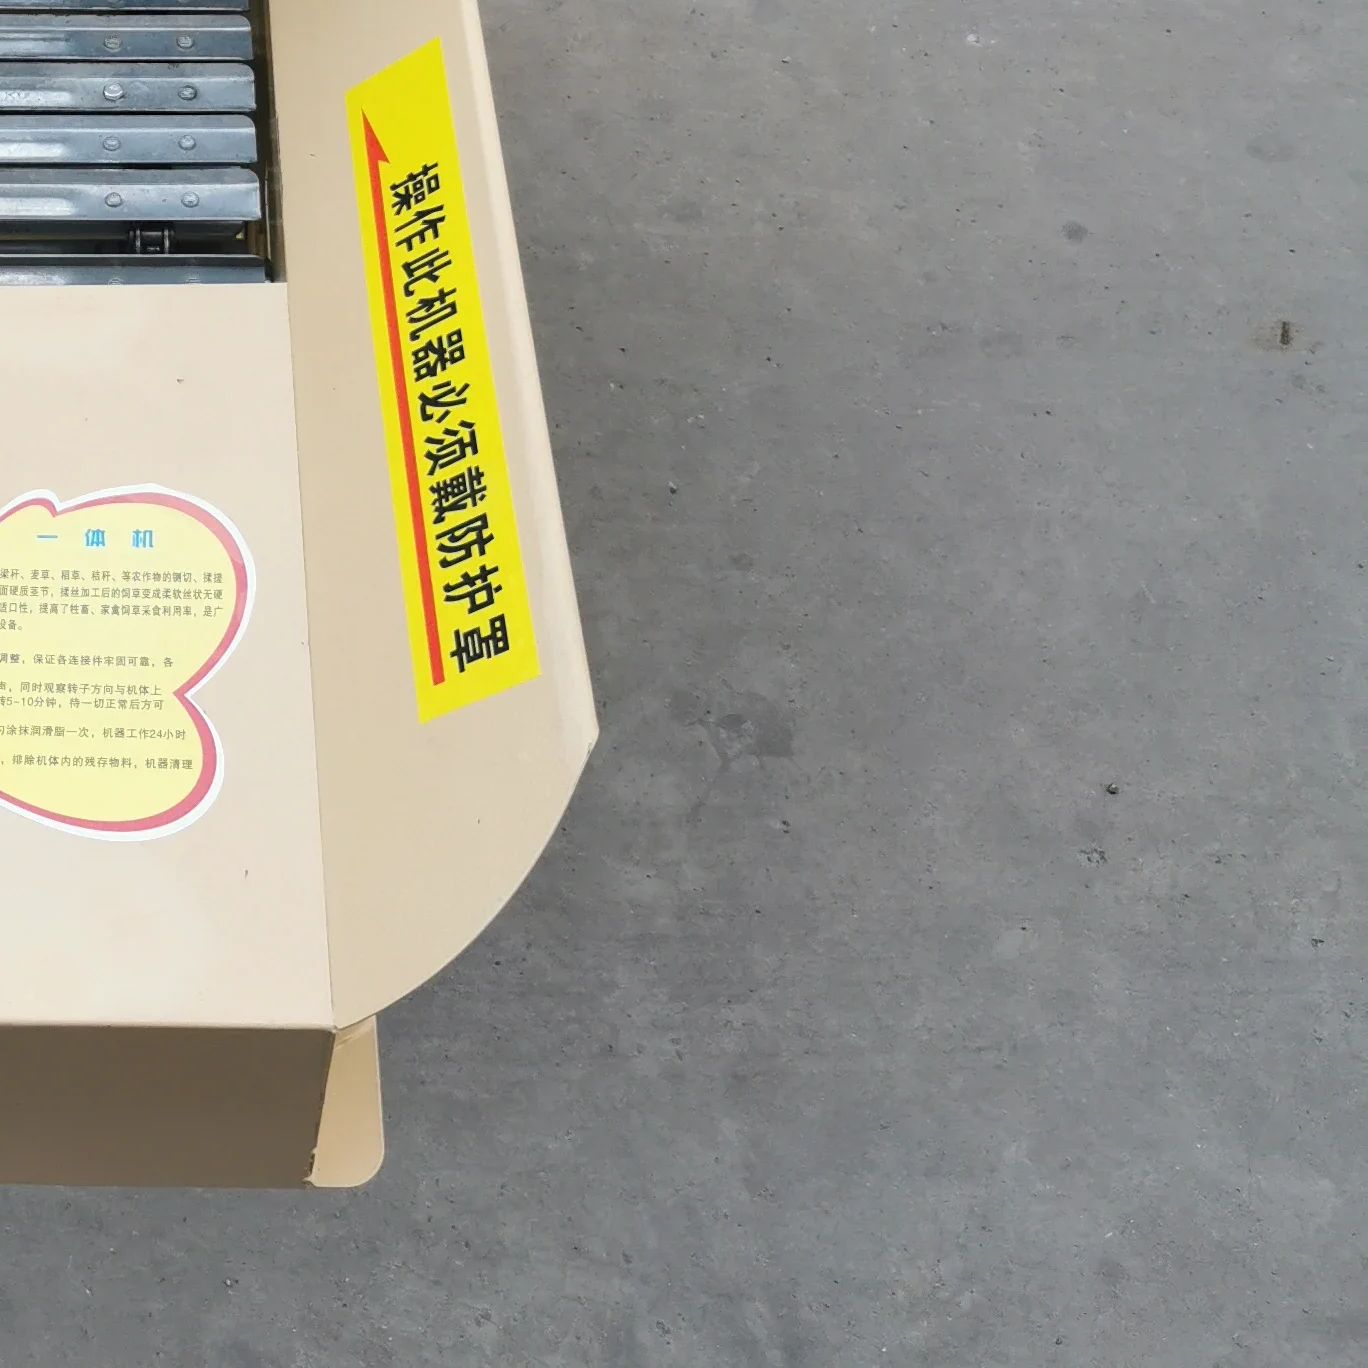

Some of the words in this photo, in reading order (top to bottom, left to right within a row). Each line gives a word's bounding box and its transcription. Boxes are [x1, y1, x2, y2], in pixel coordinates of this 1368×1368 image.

[388, 160, 511, 674] 操作此机器必须戴防护罩
